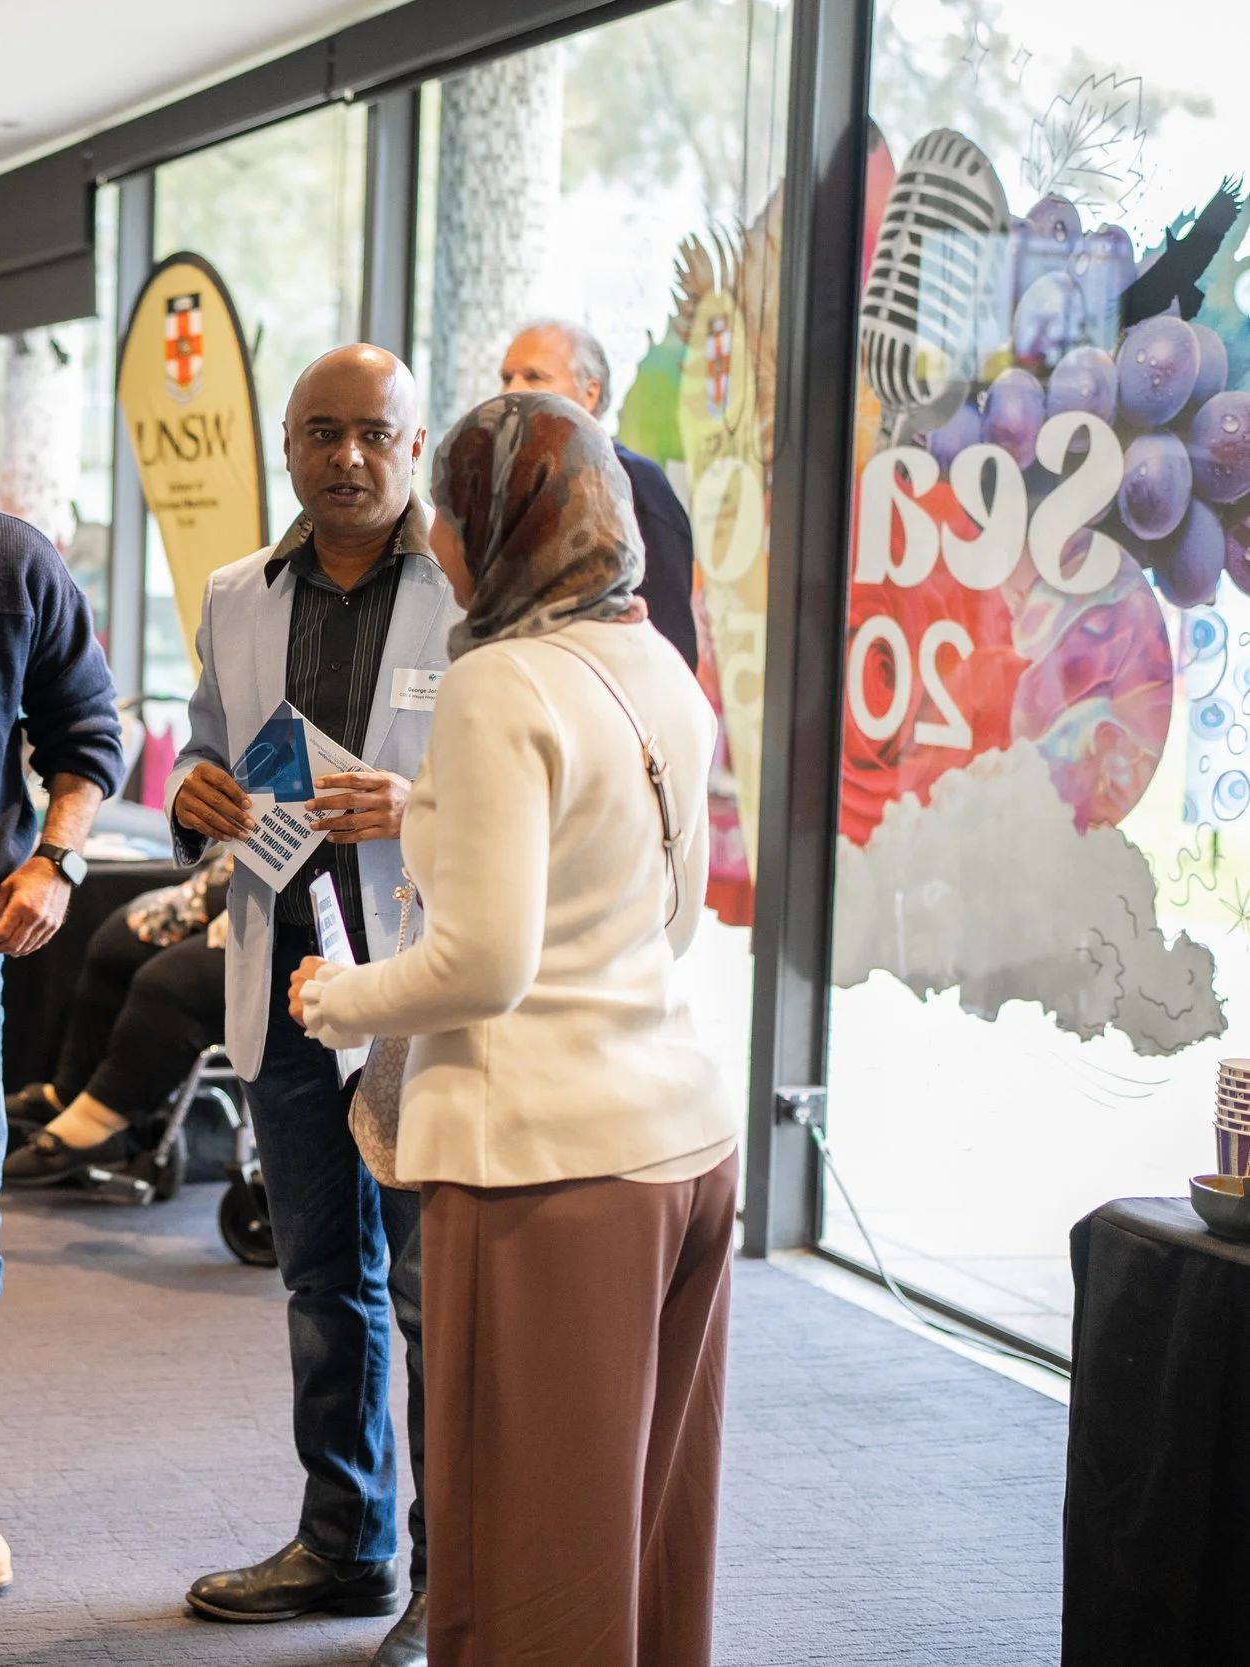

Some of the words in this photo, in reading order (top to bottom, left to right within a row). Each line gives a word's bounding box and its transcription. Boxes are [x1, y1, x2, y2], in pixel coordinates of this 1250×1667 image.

[137, 410, 234, 466] UNSW
[407, 686, 427, 694] George
[260, 814, 302, 850] INNOVATION
[271, 804, 311, 839] SHOWCASE
[245, 836, 284, 872] MURRUMBI
[260, 830, 293, 861] REGIONAL
